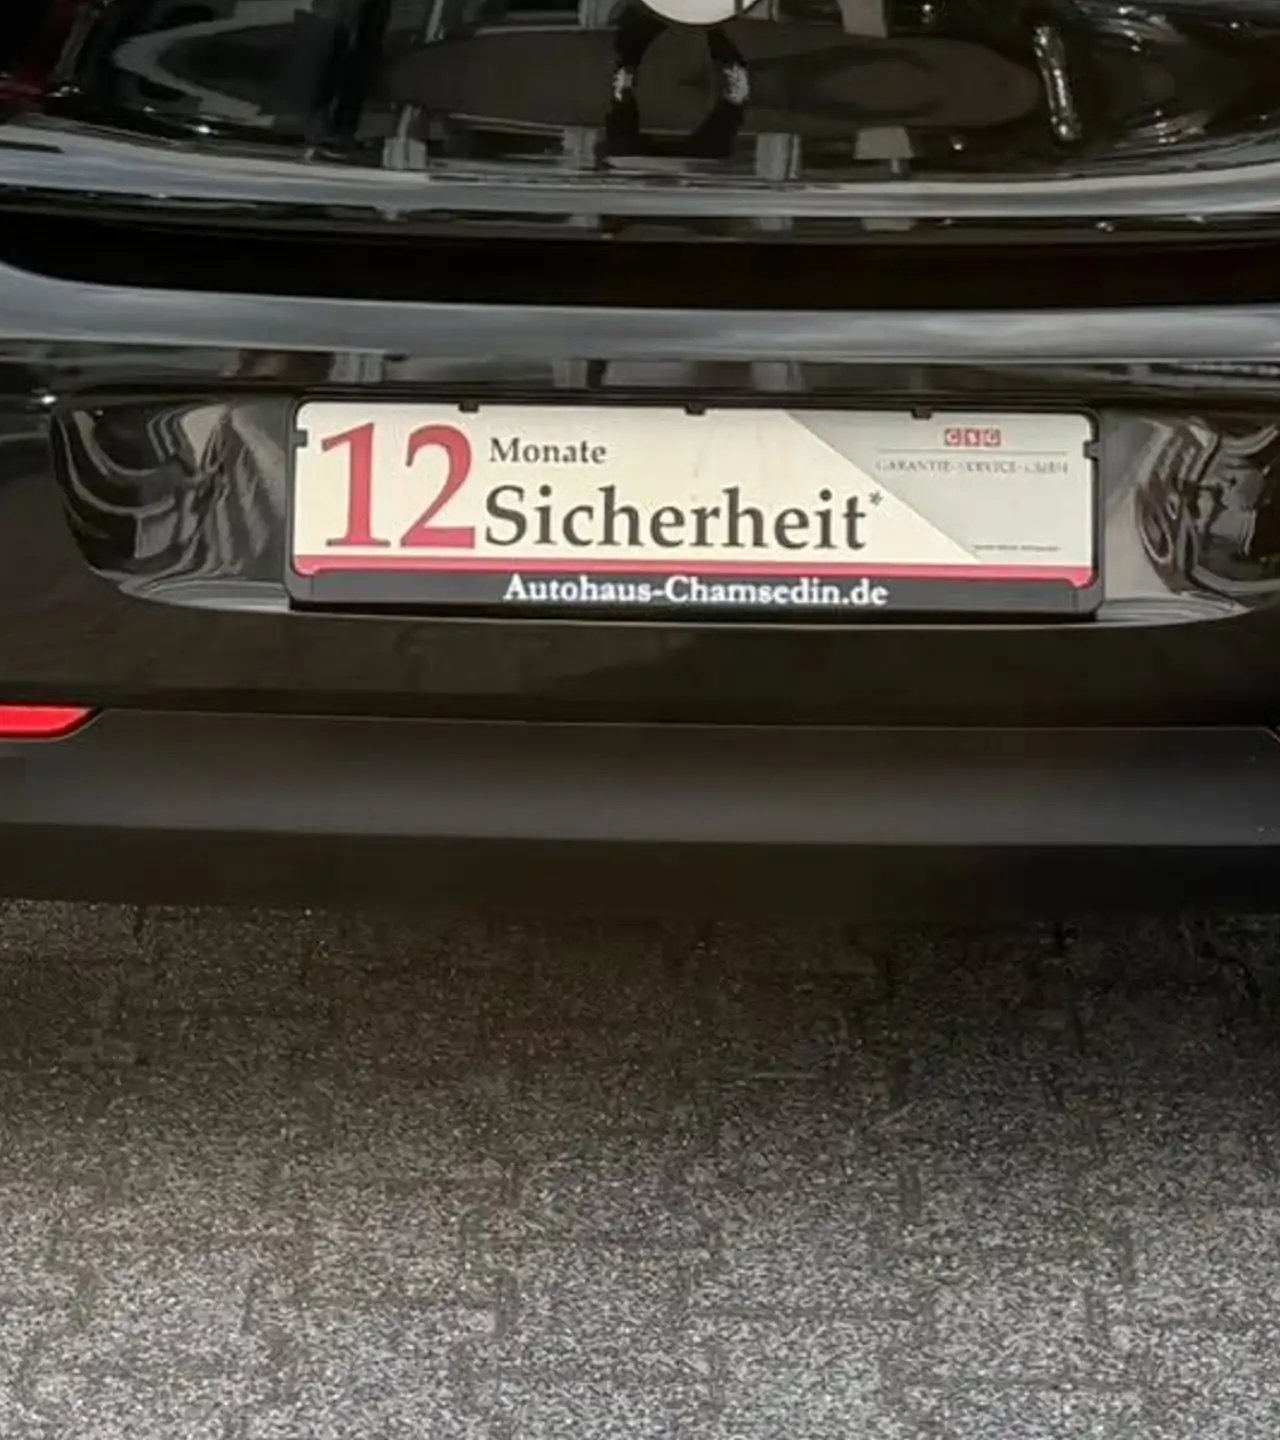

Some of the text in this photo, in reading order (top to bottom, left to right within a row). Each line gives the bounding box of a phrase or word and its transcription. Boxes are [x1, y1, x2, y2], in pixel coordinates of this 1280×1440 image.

[321, 421, 606, 550] 12 Monate
[503, 573, 889, 607] Autohaus-Chamsedin.de
